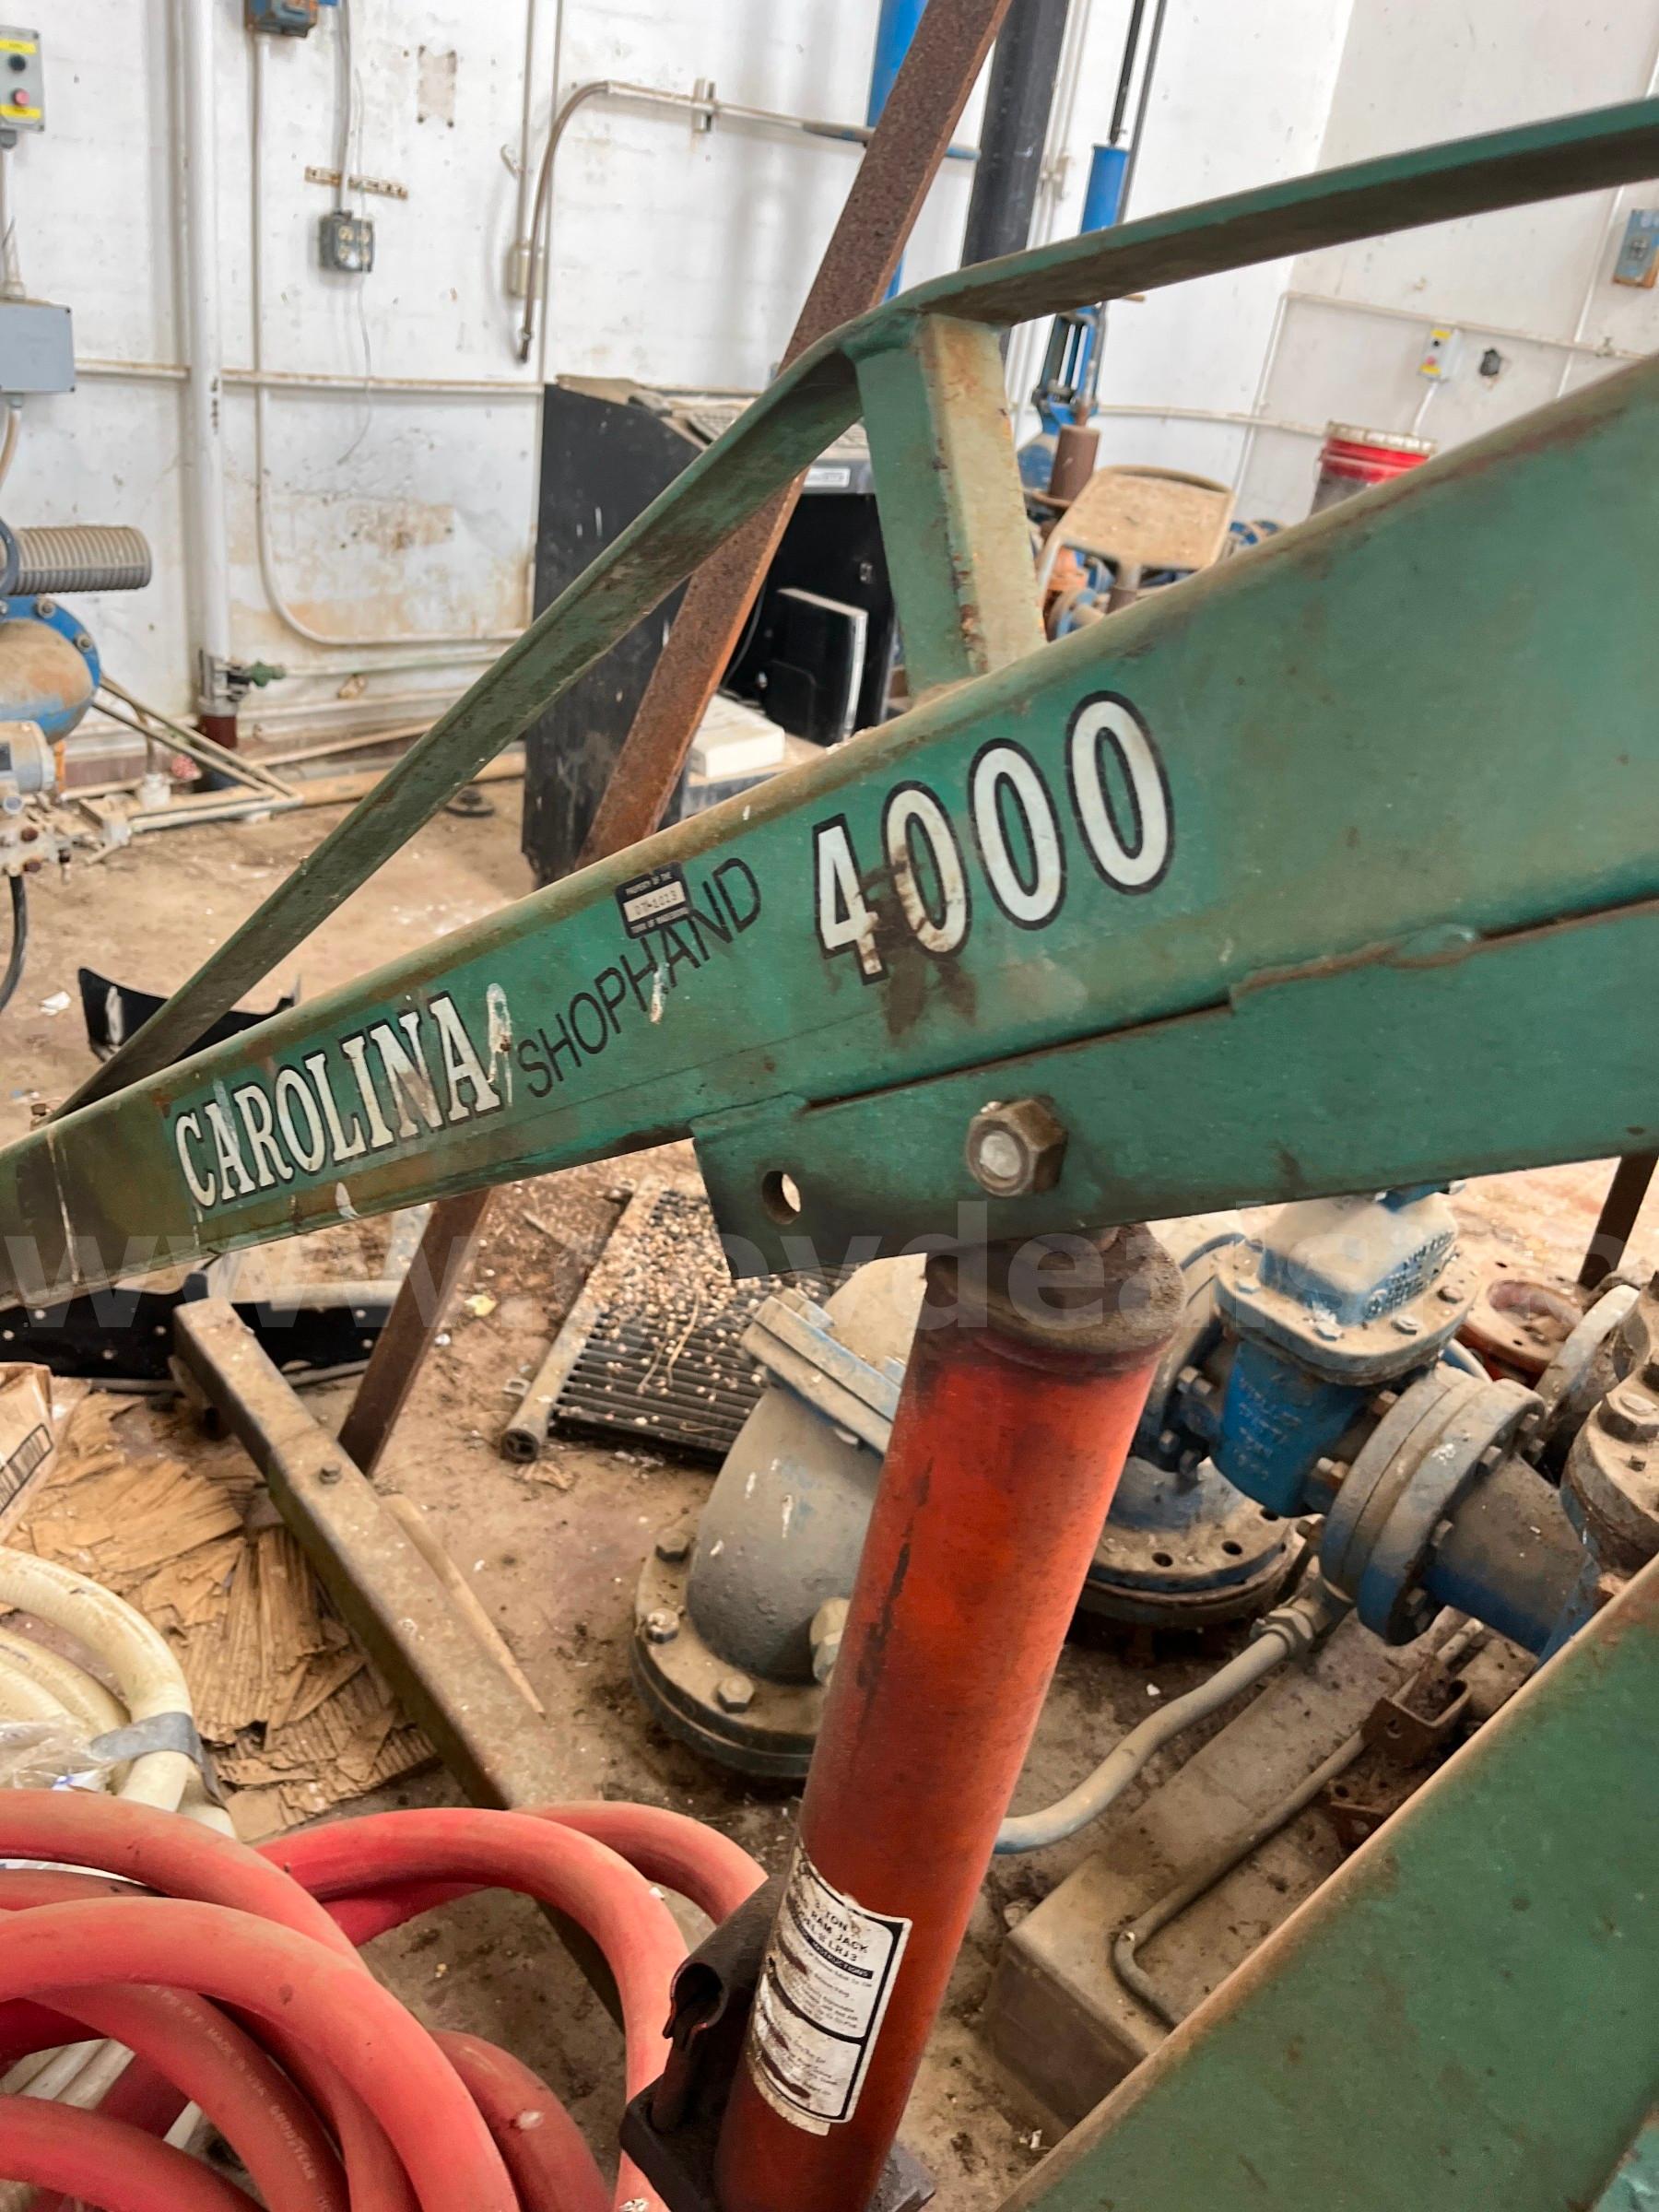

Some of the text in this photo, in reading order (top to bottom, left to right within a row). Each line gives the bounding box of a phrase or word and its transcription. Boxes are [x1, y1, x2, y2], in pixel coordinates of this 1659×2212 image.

[173, 690, 1175, 1208] CAROLINA SHOPHAND 4000
